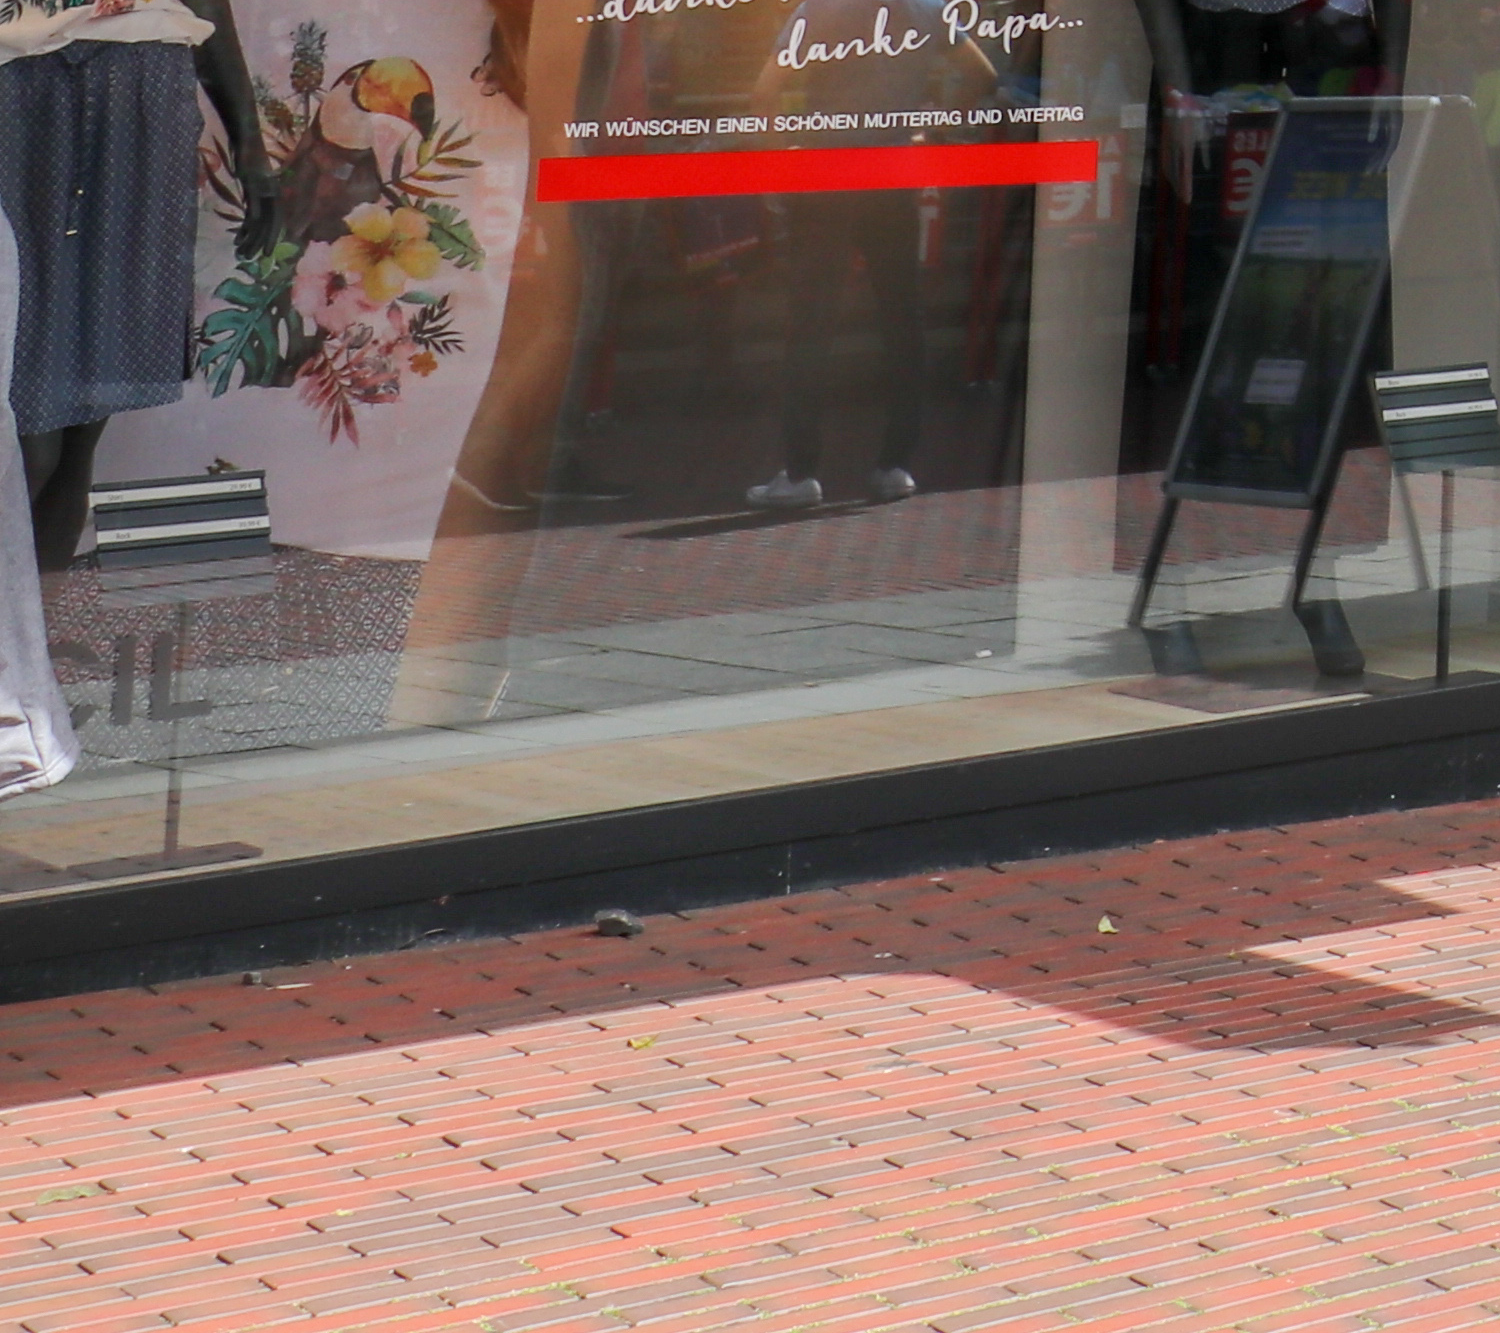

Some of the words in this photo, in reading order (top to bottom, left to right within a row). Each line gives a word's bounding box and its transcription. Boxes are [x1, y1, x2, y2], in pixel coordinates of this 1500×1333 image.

[778, 7, 931, 70] danke
[564, 121, 600, 138] WIR
[606, 115, 710, 137] WÜNSCHEN
[716, 117, 768, 134] EINEN
[774, 111, 858, 132] SCHÖNEN
[864, 110, 963, 129] MUTTERTAG
[968, 109, 1003, 125] UND
[1008, 106, 1085, 124] VATERTAG
